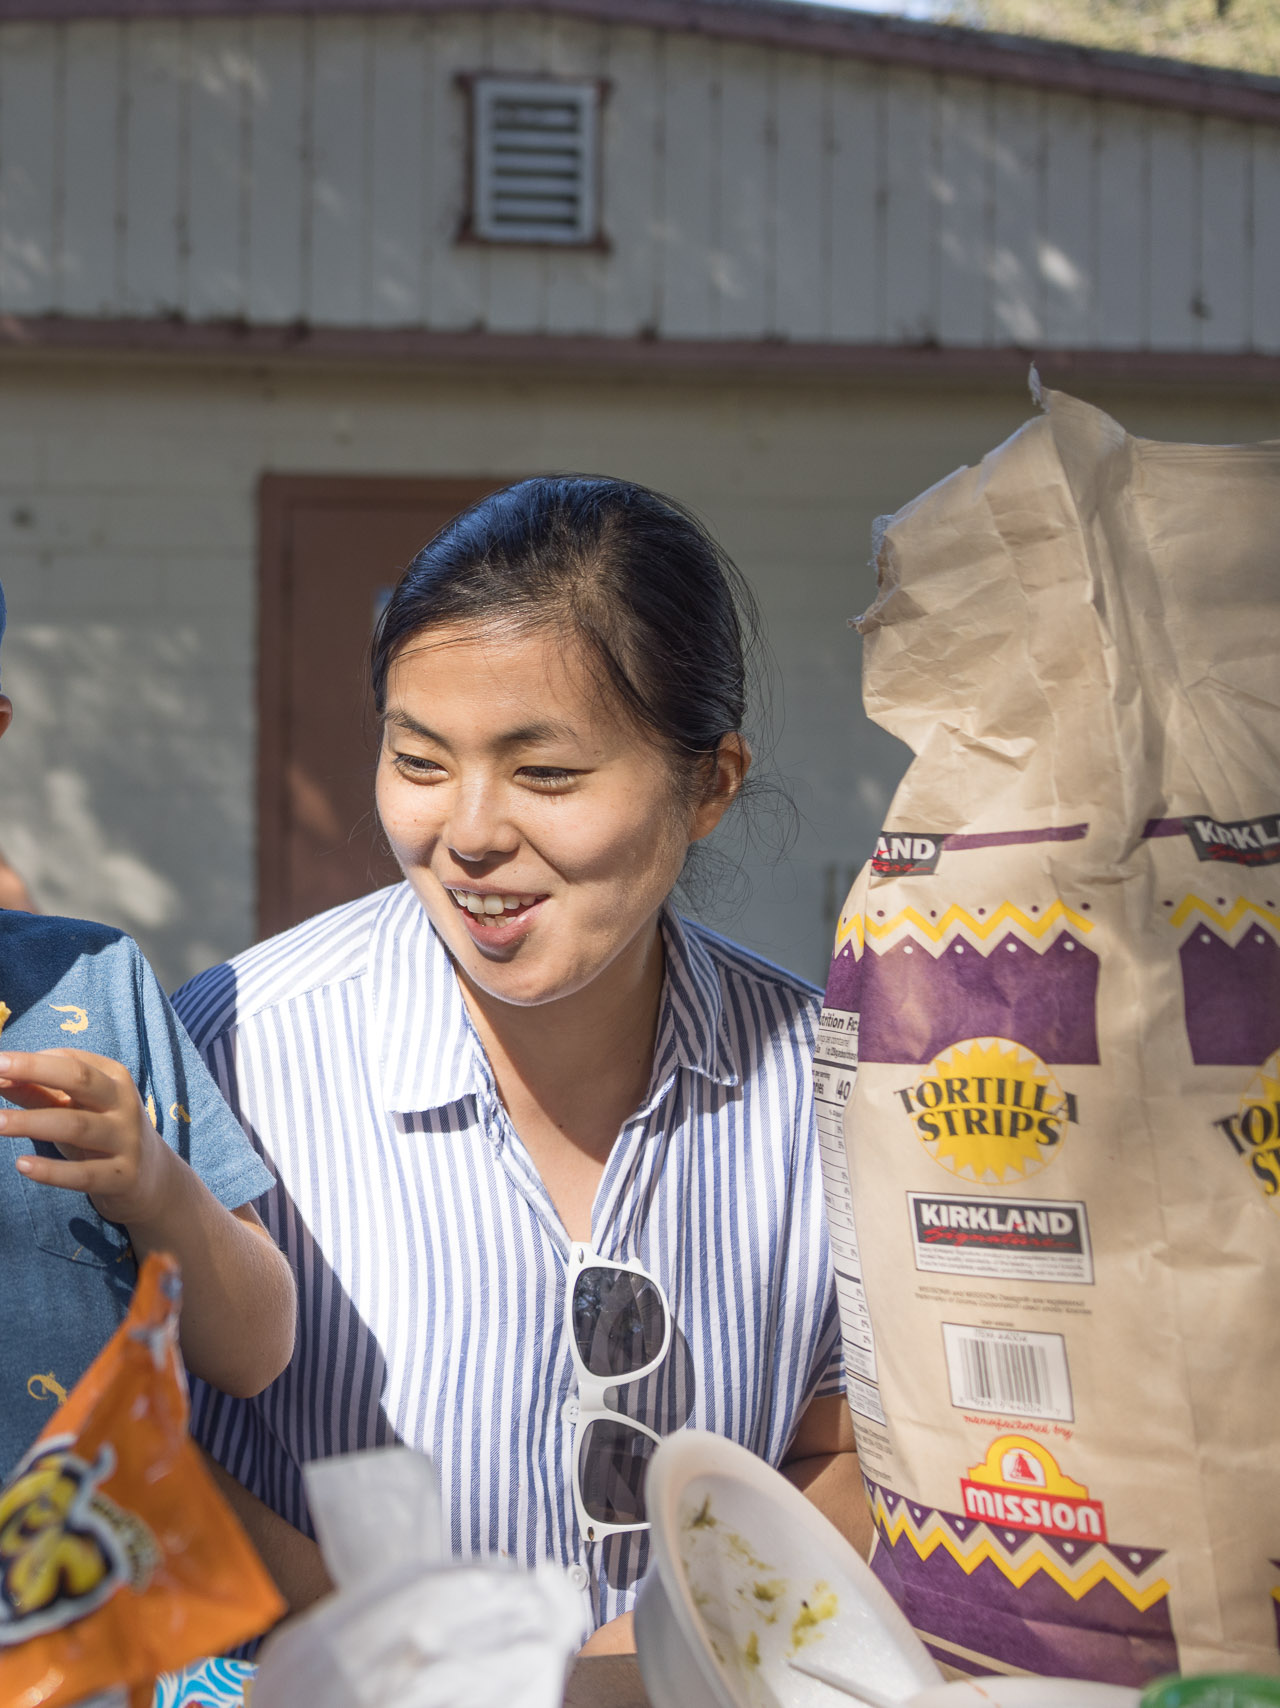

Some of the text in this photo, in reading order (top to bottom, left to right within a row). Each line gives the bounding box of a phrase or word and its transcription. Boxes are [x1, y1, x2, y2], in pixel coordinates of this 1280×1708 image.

[872, 836, 936, 860] AND
[894, 1077, 1080, 1125] TORTILLA
[917, 1108, 1063, 1146] STRIPS
[920, 1203, 1074, 1236] KIRKLAND
[964, 1486, 1102, 1537] MISSION
